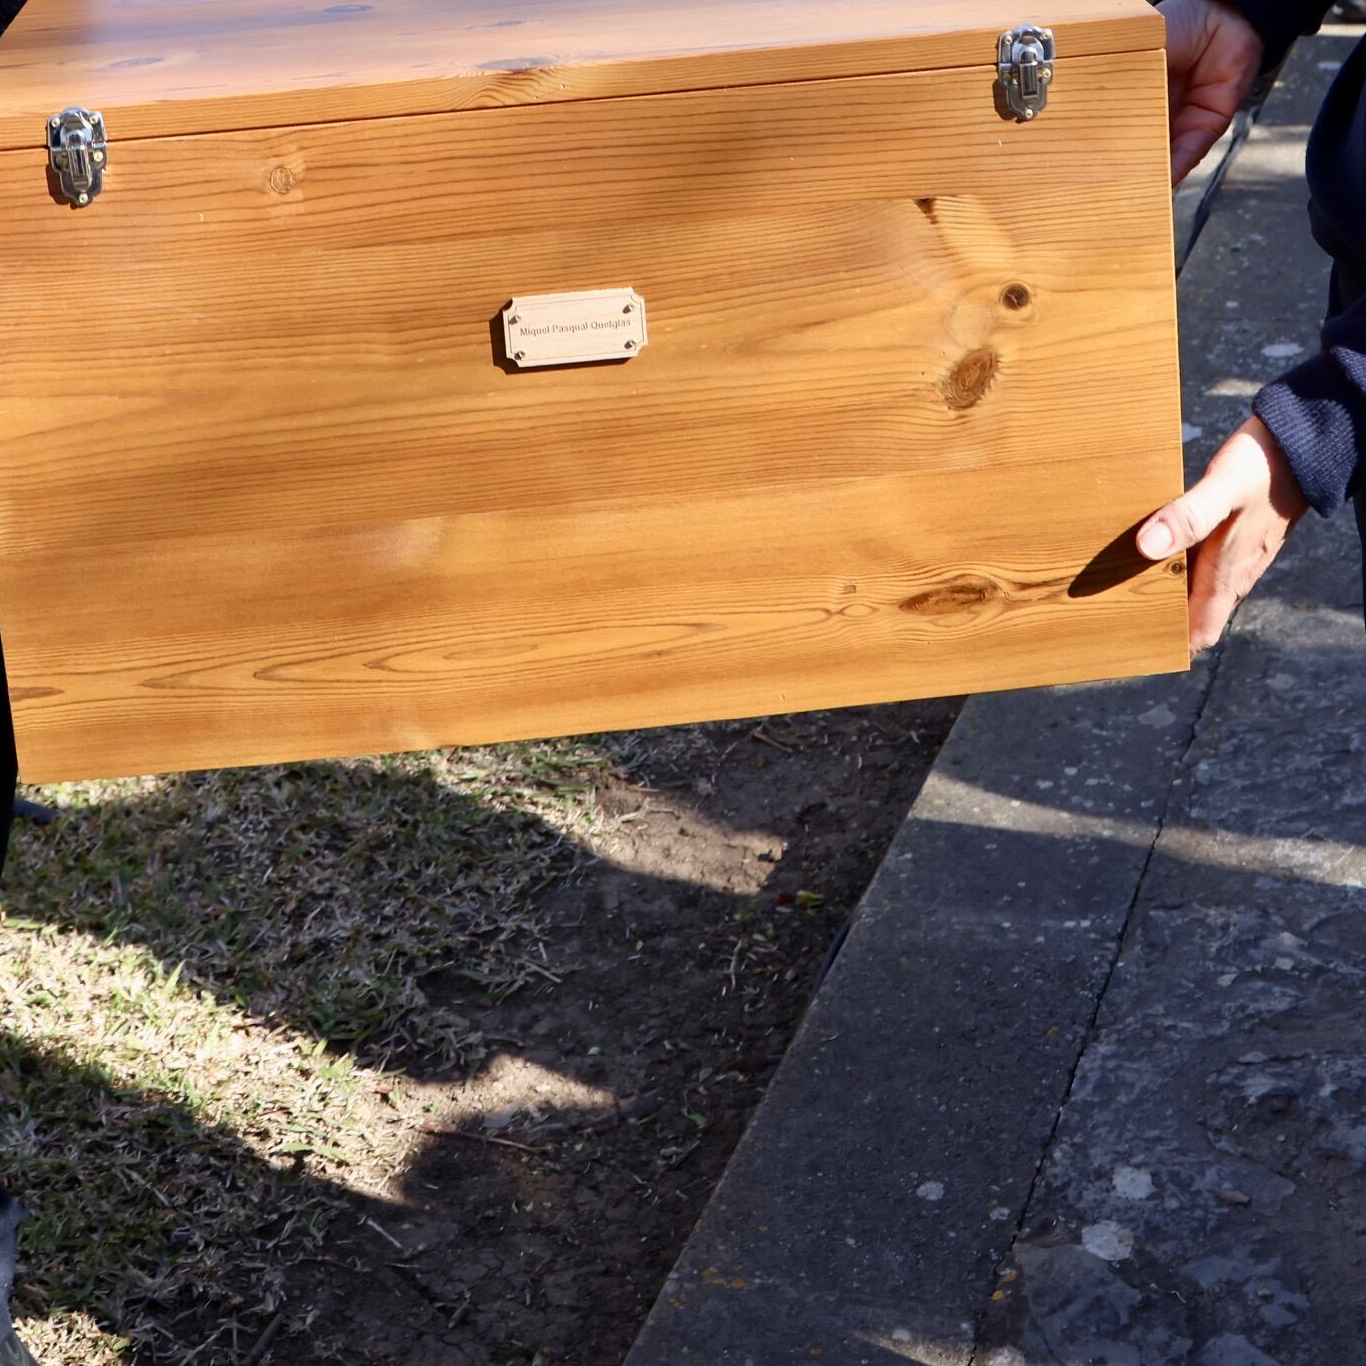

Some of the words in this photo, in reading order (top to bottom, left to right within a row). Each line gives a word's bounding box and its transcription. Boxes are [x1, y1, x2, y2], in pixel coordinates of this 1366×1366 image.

[520, 325, 550, 338] Miquel
[552, 321, 588, 334] Pasqual
[592, 318, 631, 331] Quetglas
